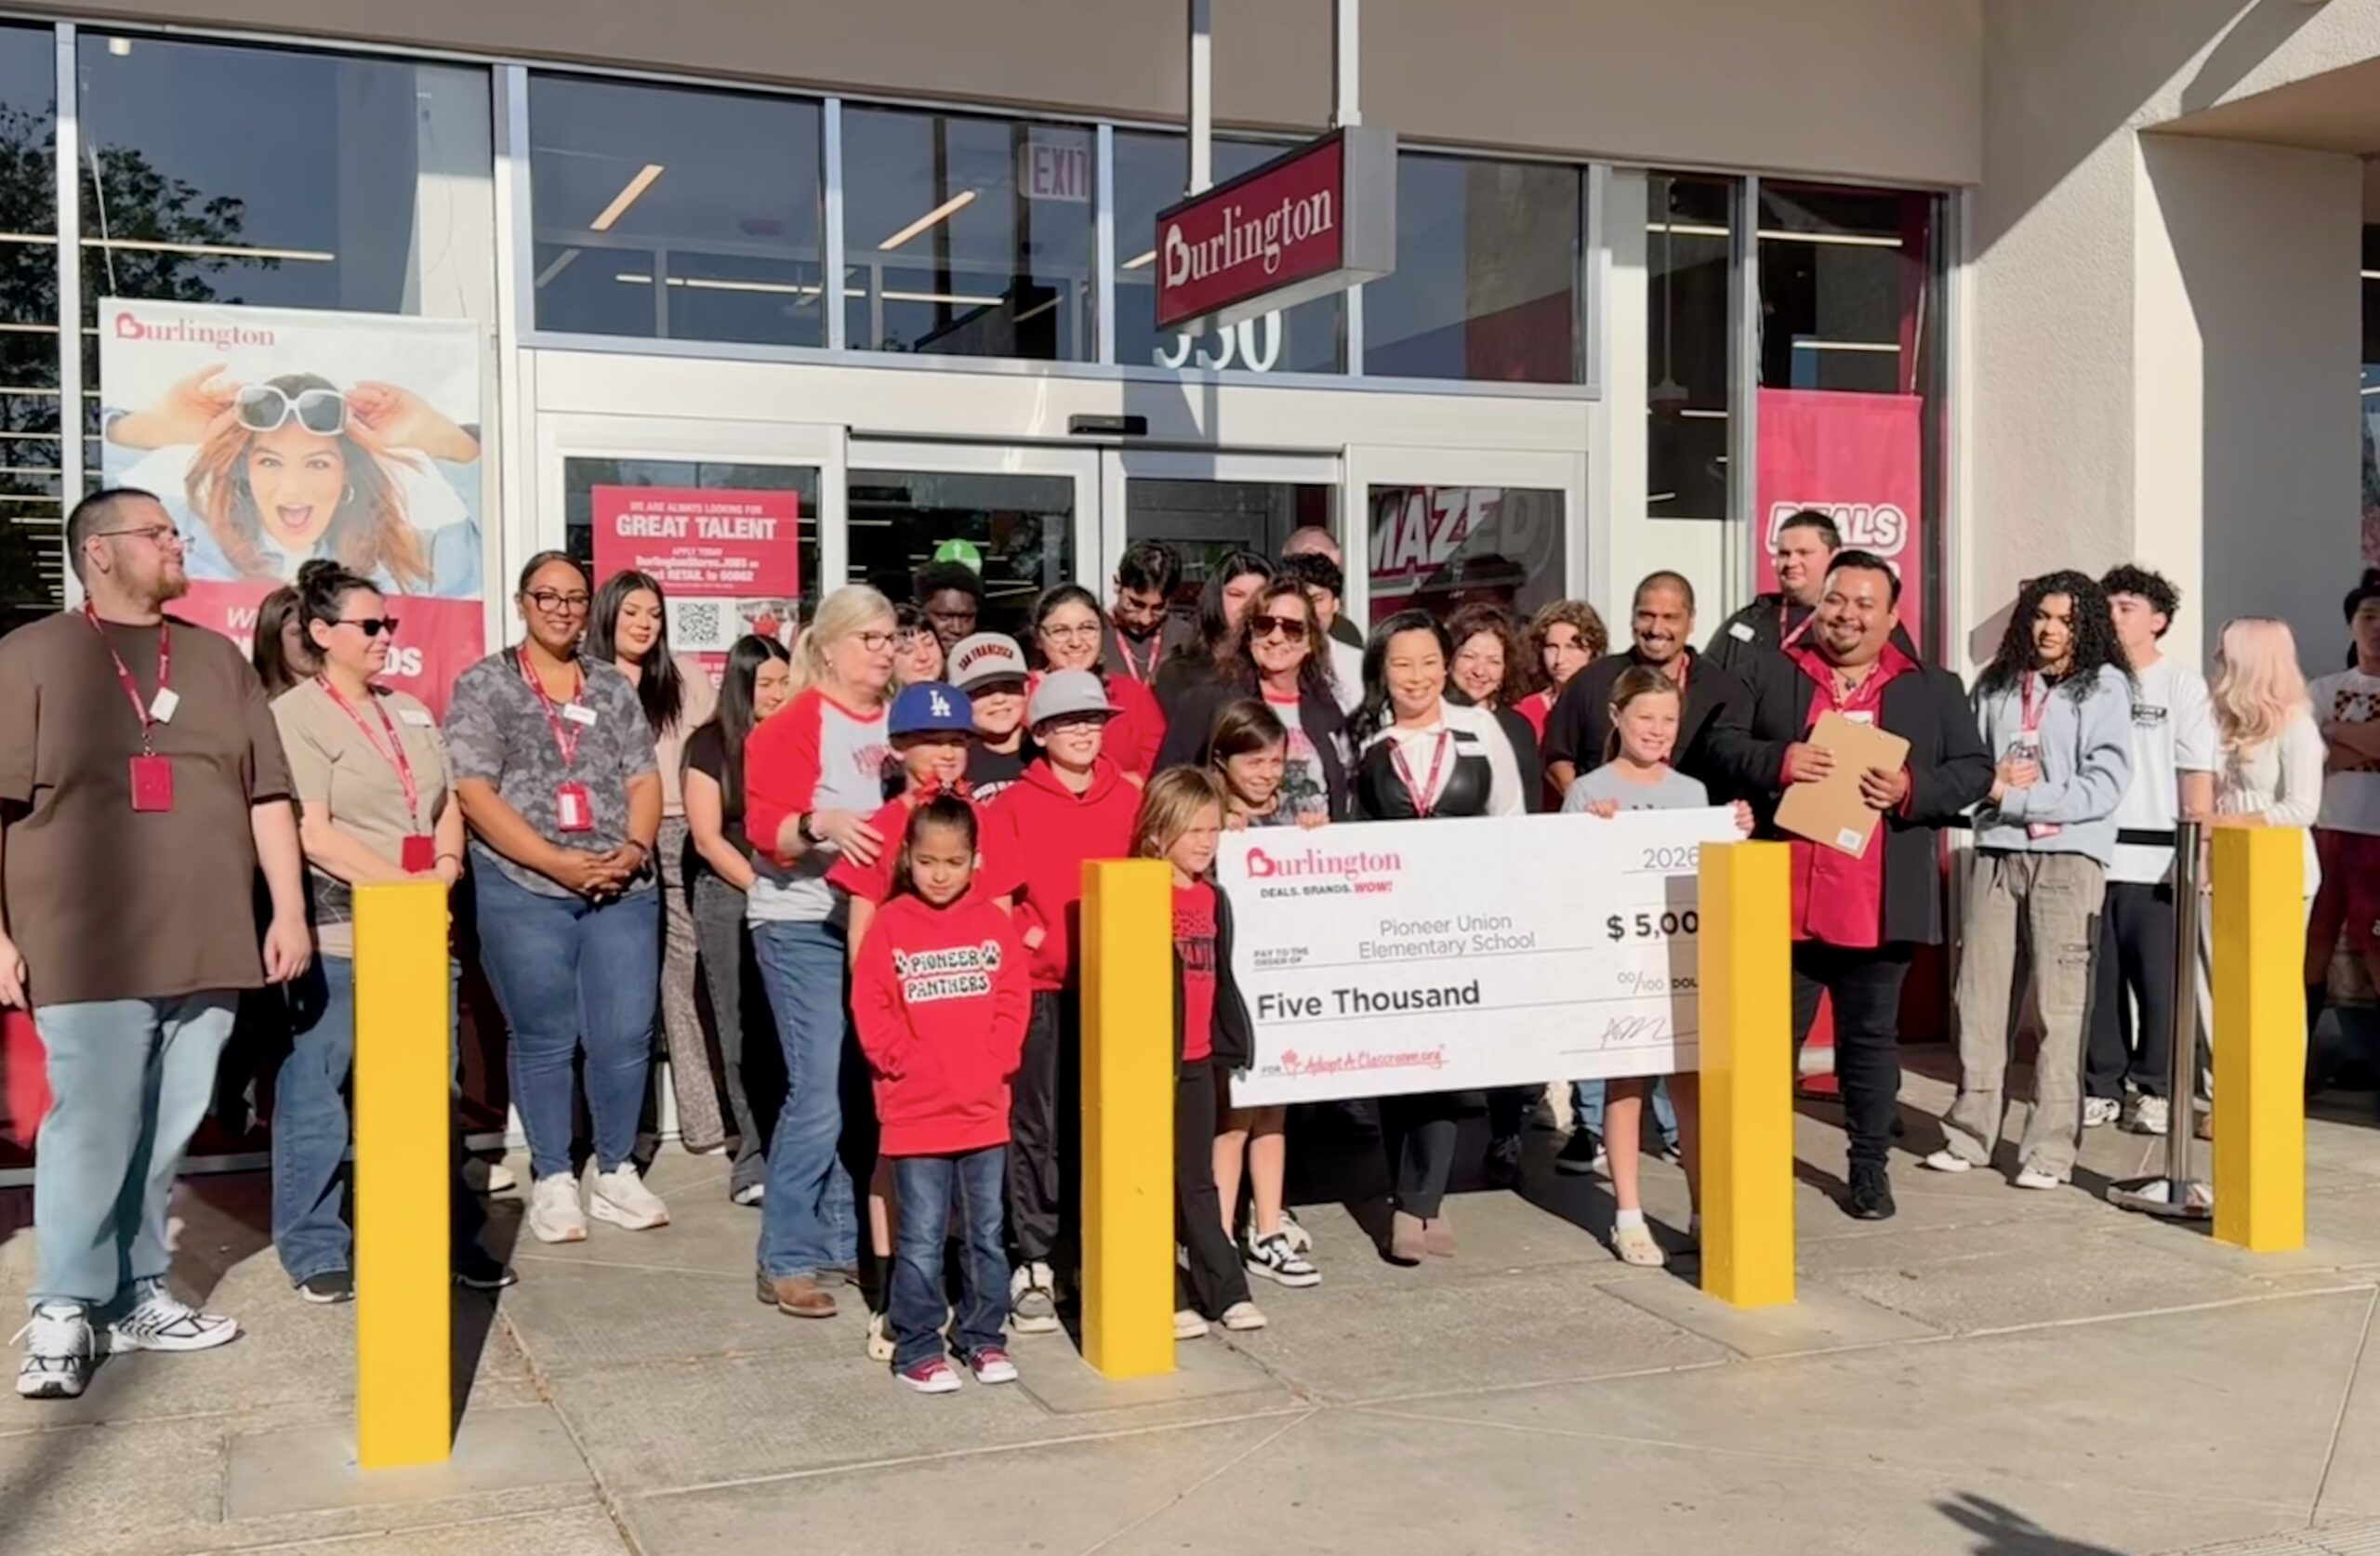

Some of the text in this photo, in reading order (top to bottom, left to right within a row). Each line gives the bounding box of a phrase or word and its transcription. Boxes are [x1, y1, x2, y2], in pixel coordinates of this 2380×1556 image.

[1033, 146, 1086, 196] EXIT
[1165, 190, 1333, 289] Burlington
[114, 311, 275, 351] Burlington
[646, 502, 664, 511] ARE
[745, 505, 763, 514] FOR
[615, 514, 777, 540] GREAT TALENT
[930, 690, 951, 717] LA
[1247, 847, 1402, 880] Burlington
[1643, 846, 1699, 869] 2026
[1354, 881, 1393, 894] WOW!
[1380, 913, 1512, 937] Pioneer Union
[1359, 930, 1536, 959] Elementary School
[911, 949, 980, 972] PIONEER
[908, 975, 987, 998] PANTHERS
[1257, 979, 1481, 1020] Five Thousand
